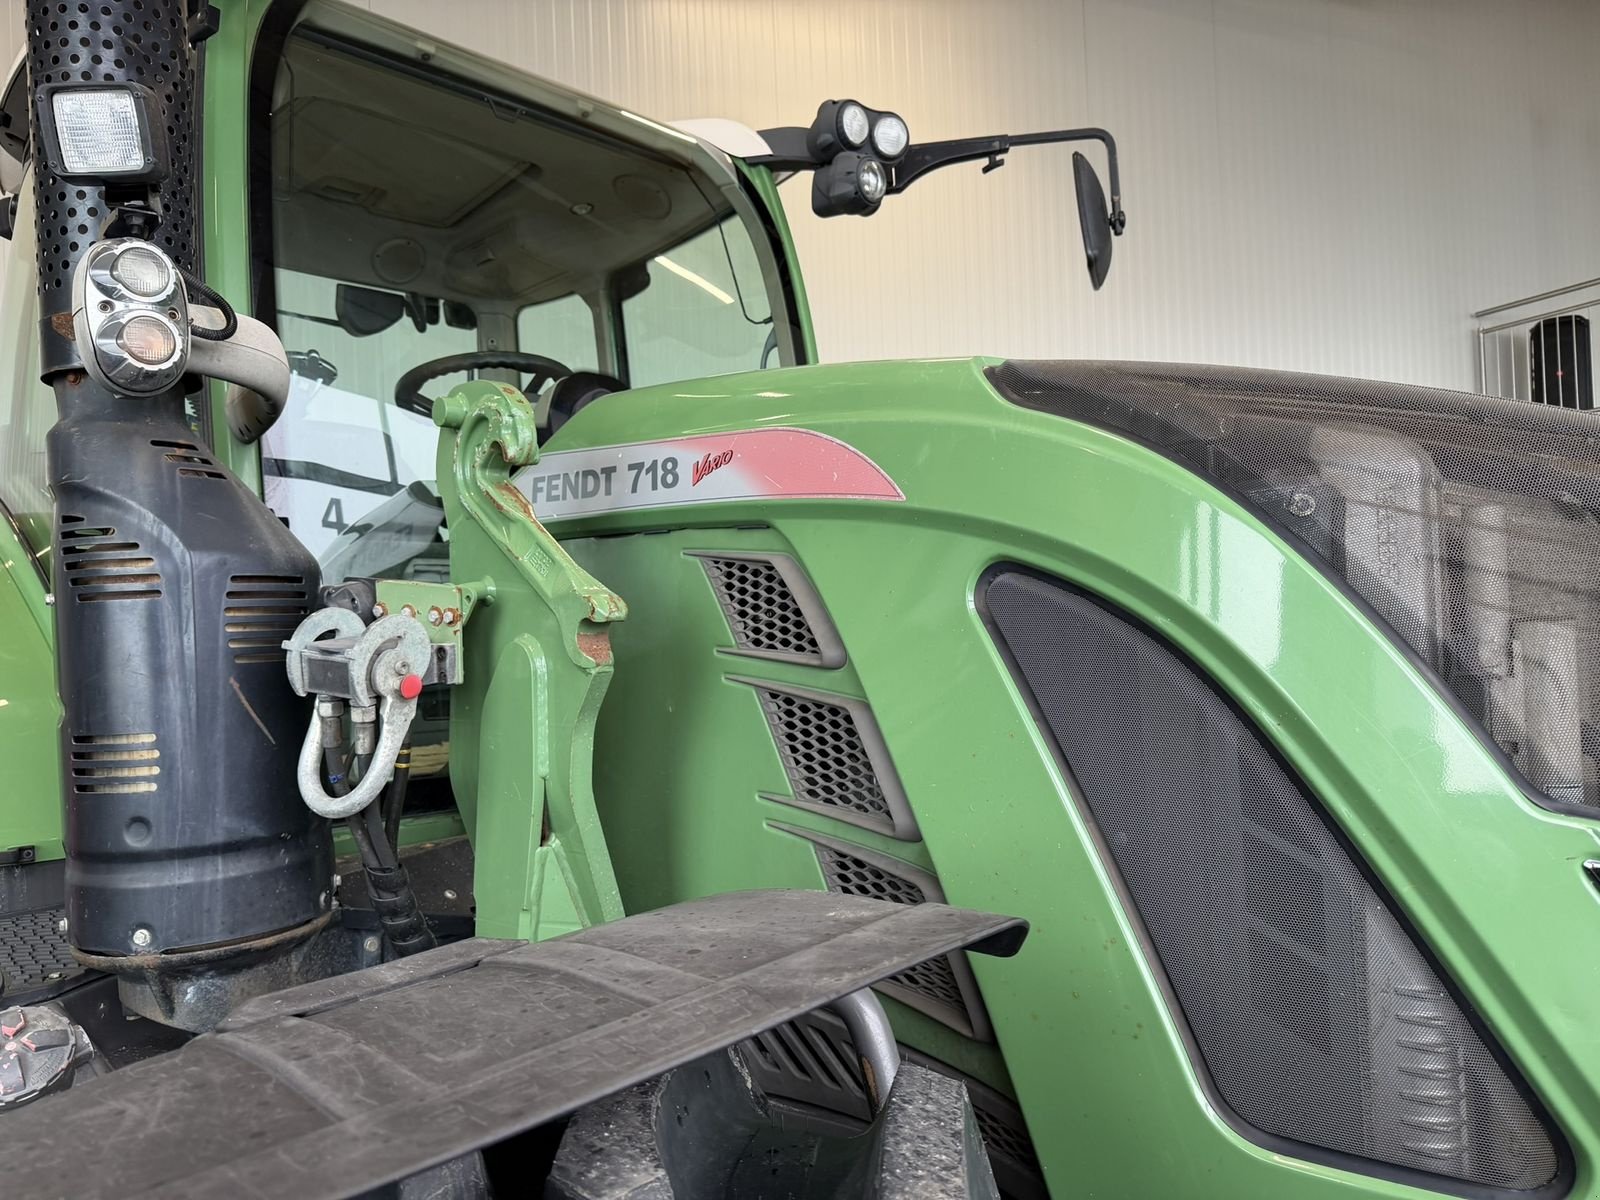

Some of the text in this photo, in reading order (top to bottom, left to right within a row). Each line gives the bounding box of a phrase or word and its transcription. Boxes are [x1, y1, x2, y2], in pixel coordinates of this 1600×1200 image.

[532, 466, 617, 503] FENDT
[627, 456, 680, 494] 718
[321, 497, 349, 535] 4
